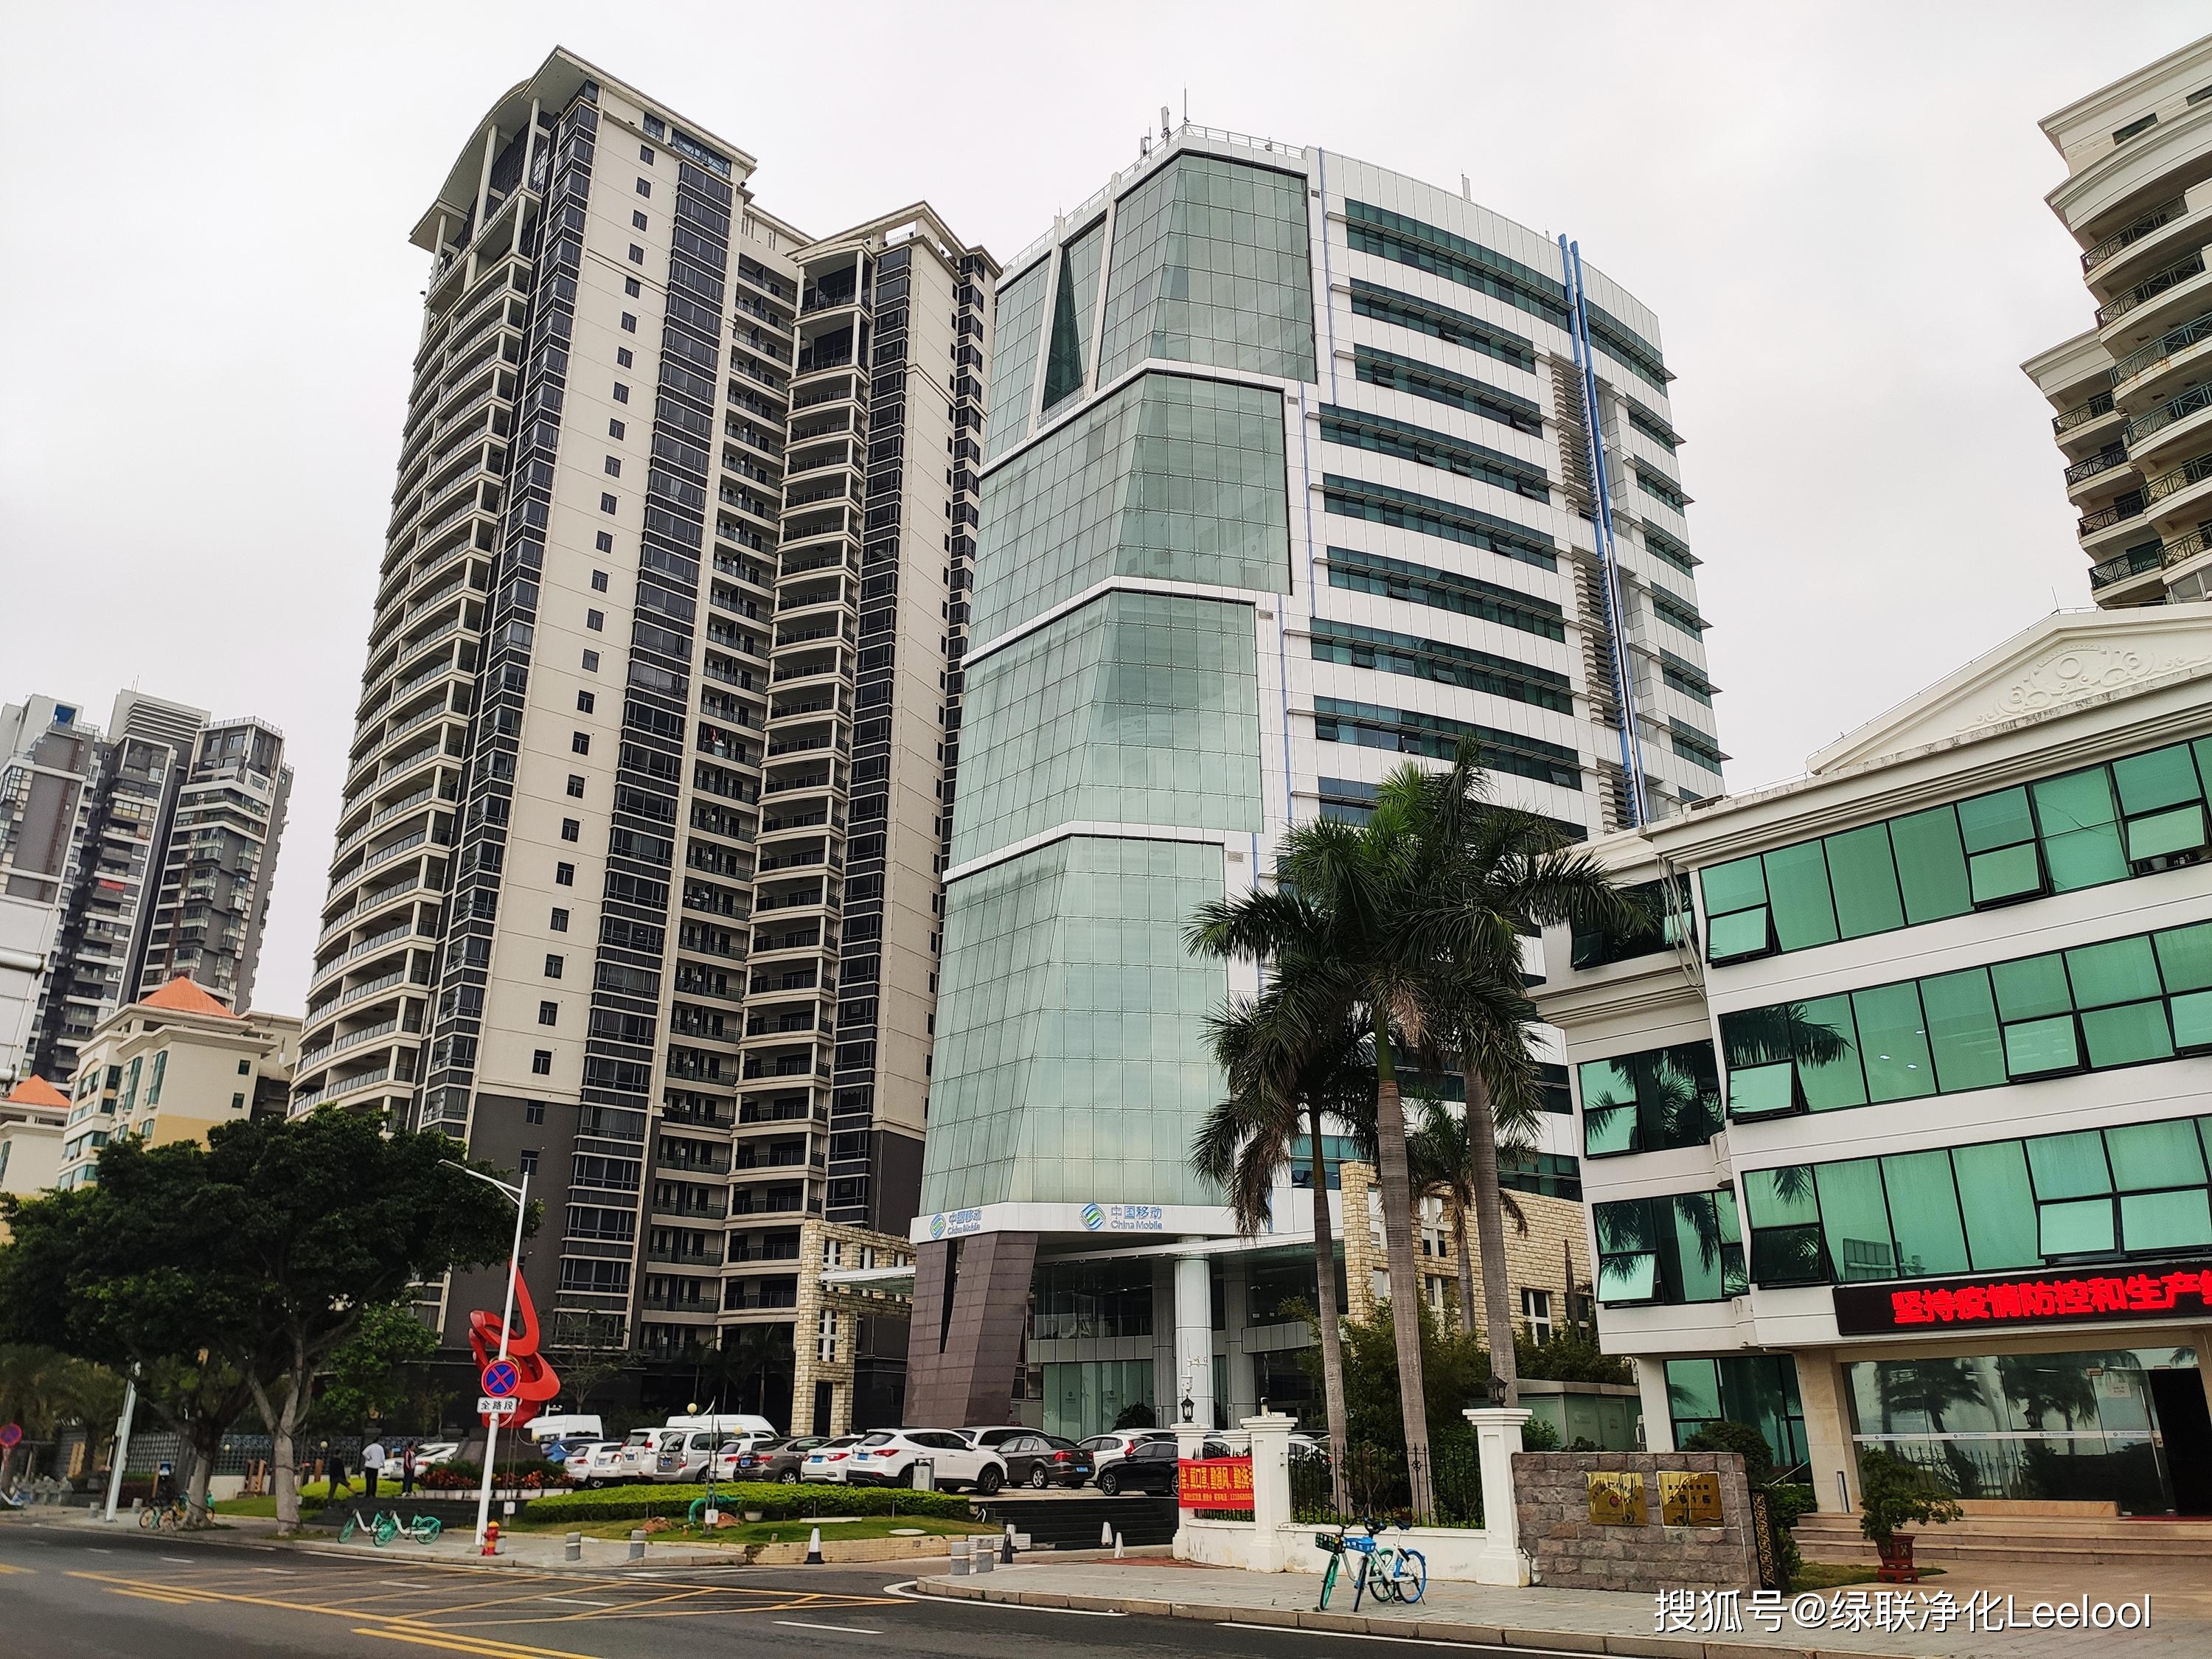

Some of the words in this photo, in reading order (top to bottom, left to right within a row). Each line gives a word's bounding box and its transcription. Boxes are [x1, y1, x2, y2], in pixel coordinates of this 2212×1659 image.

[949, 1208, 981, 1225] 中国移动
[1110, 1205, 1162, 1220] 中国移动
[947, 1225, 962, 1235] China
[963, 1222, 981, 1232] Mobile
[1110, 1220, 1135, 1230] China
[1136, 1220, 1163, 1230] Mobile
[481, 1399, 513, 1411] 全路段
